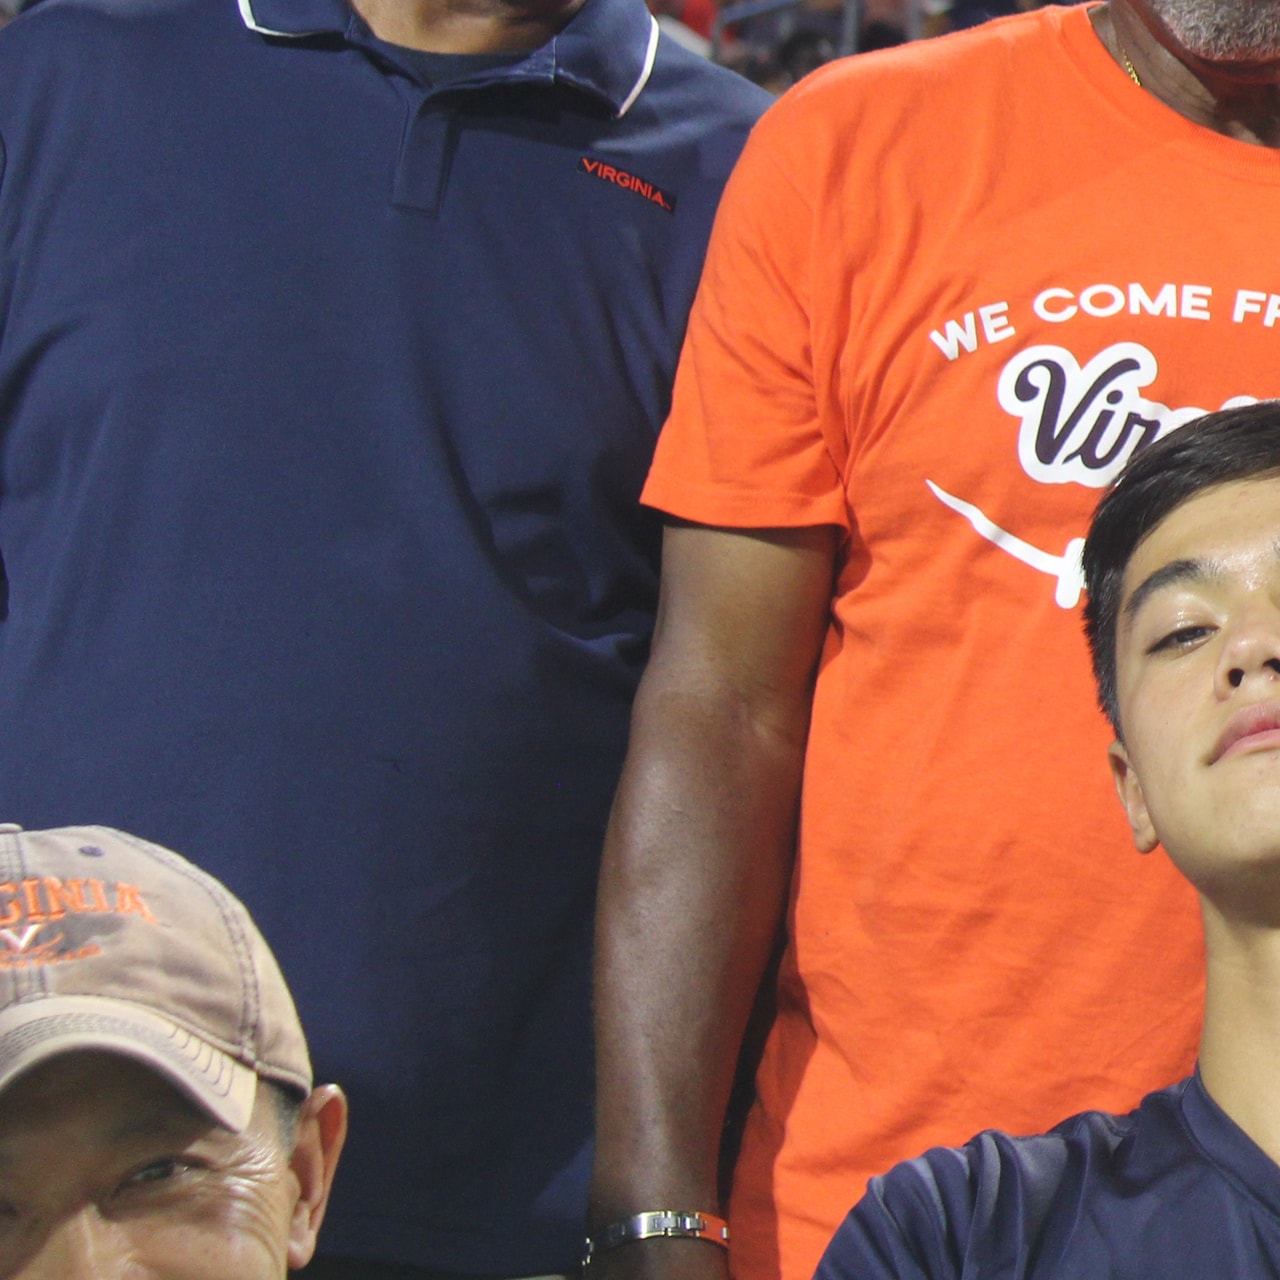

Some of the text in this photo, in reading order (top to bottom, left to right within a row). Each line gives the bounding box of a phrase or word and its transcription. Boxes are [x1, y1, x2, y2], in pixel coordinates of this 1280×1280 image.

[582, 157, 666, 208] VIRGINIA
[929, 302, 1015, 361] WE
[1033, 283, 1213, 322] COME
